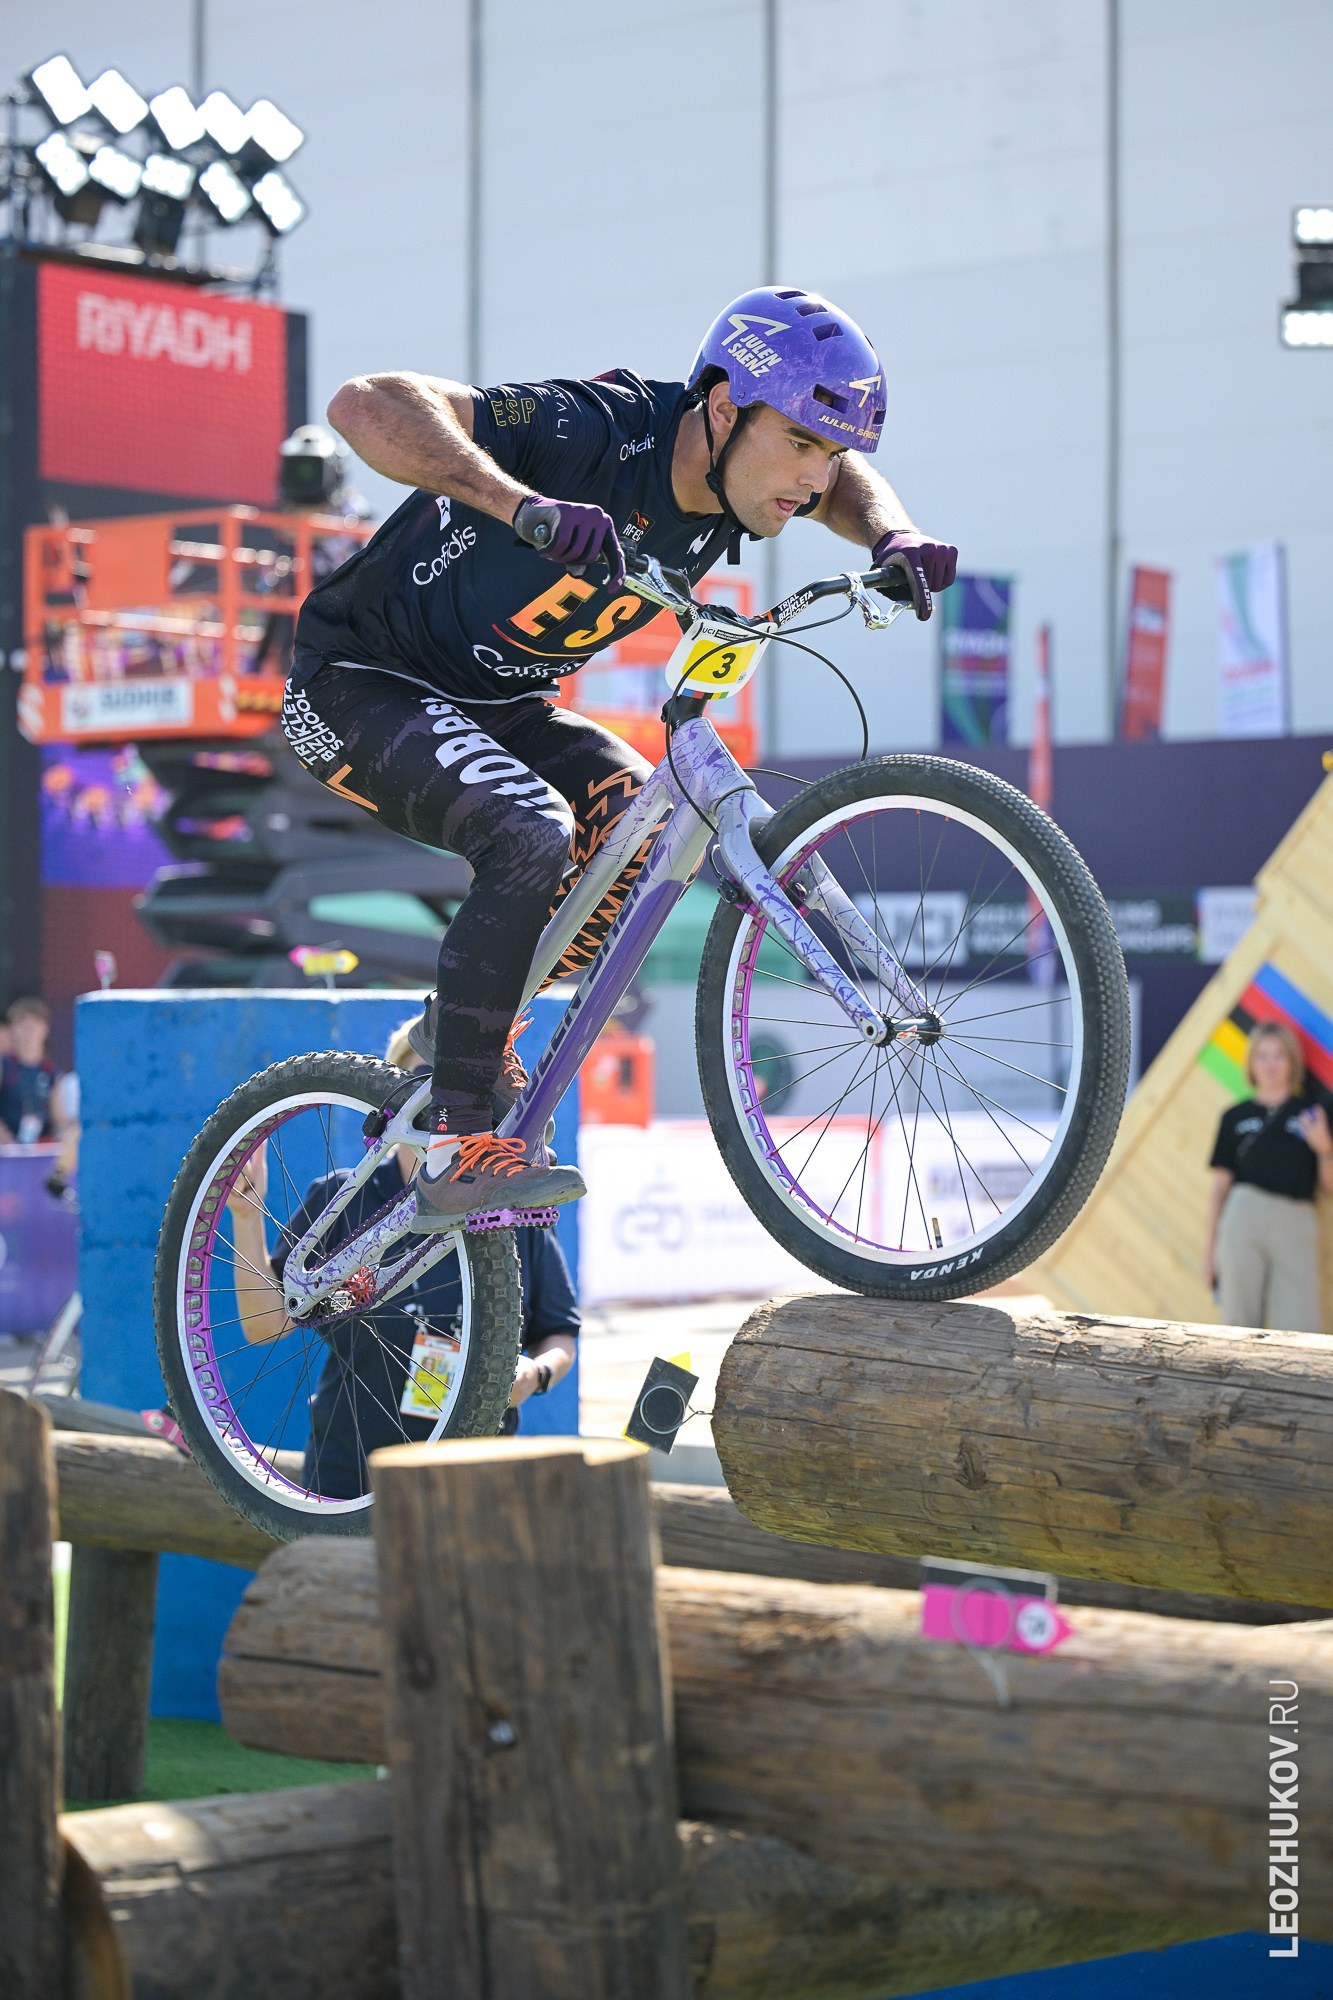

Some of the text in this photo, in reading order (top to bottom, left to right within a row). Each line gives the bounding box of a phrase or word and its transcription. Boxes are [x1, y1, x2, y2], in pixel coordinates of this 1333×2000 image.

[76, 291, 252, 373] RIYADH
[728, 342, 770, 378] SAENZ
[740, 333, 782, 367] JULEN
[491, 397, 536, 427] ESP
[818, 415, 880, 441] JULEN SAENZ
[412, 525, 477, 586] Cofidis
[702, 627, 716, 635] UCI
[712, 652, 737, 679] 3
[293, 688, 345, 751] SCHOOL
[514, 992, 583, 1122] JULEN
[911, 1248, 984, 1282] KENDA
